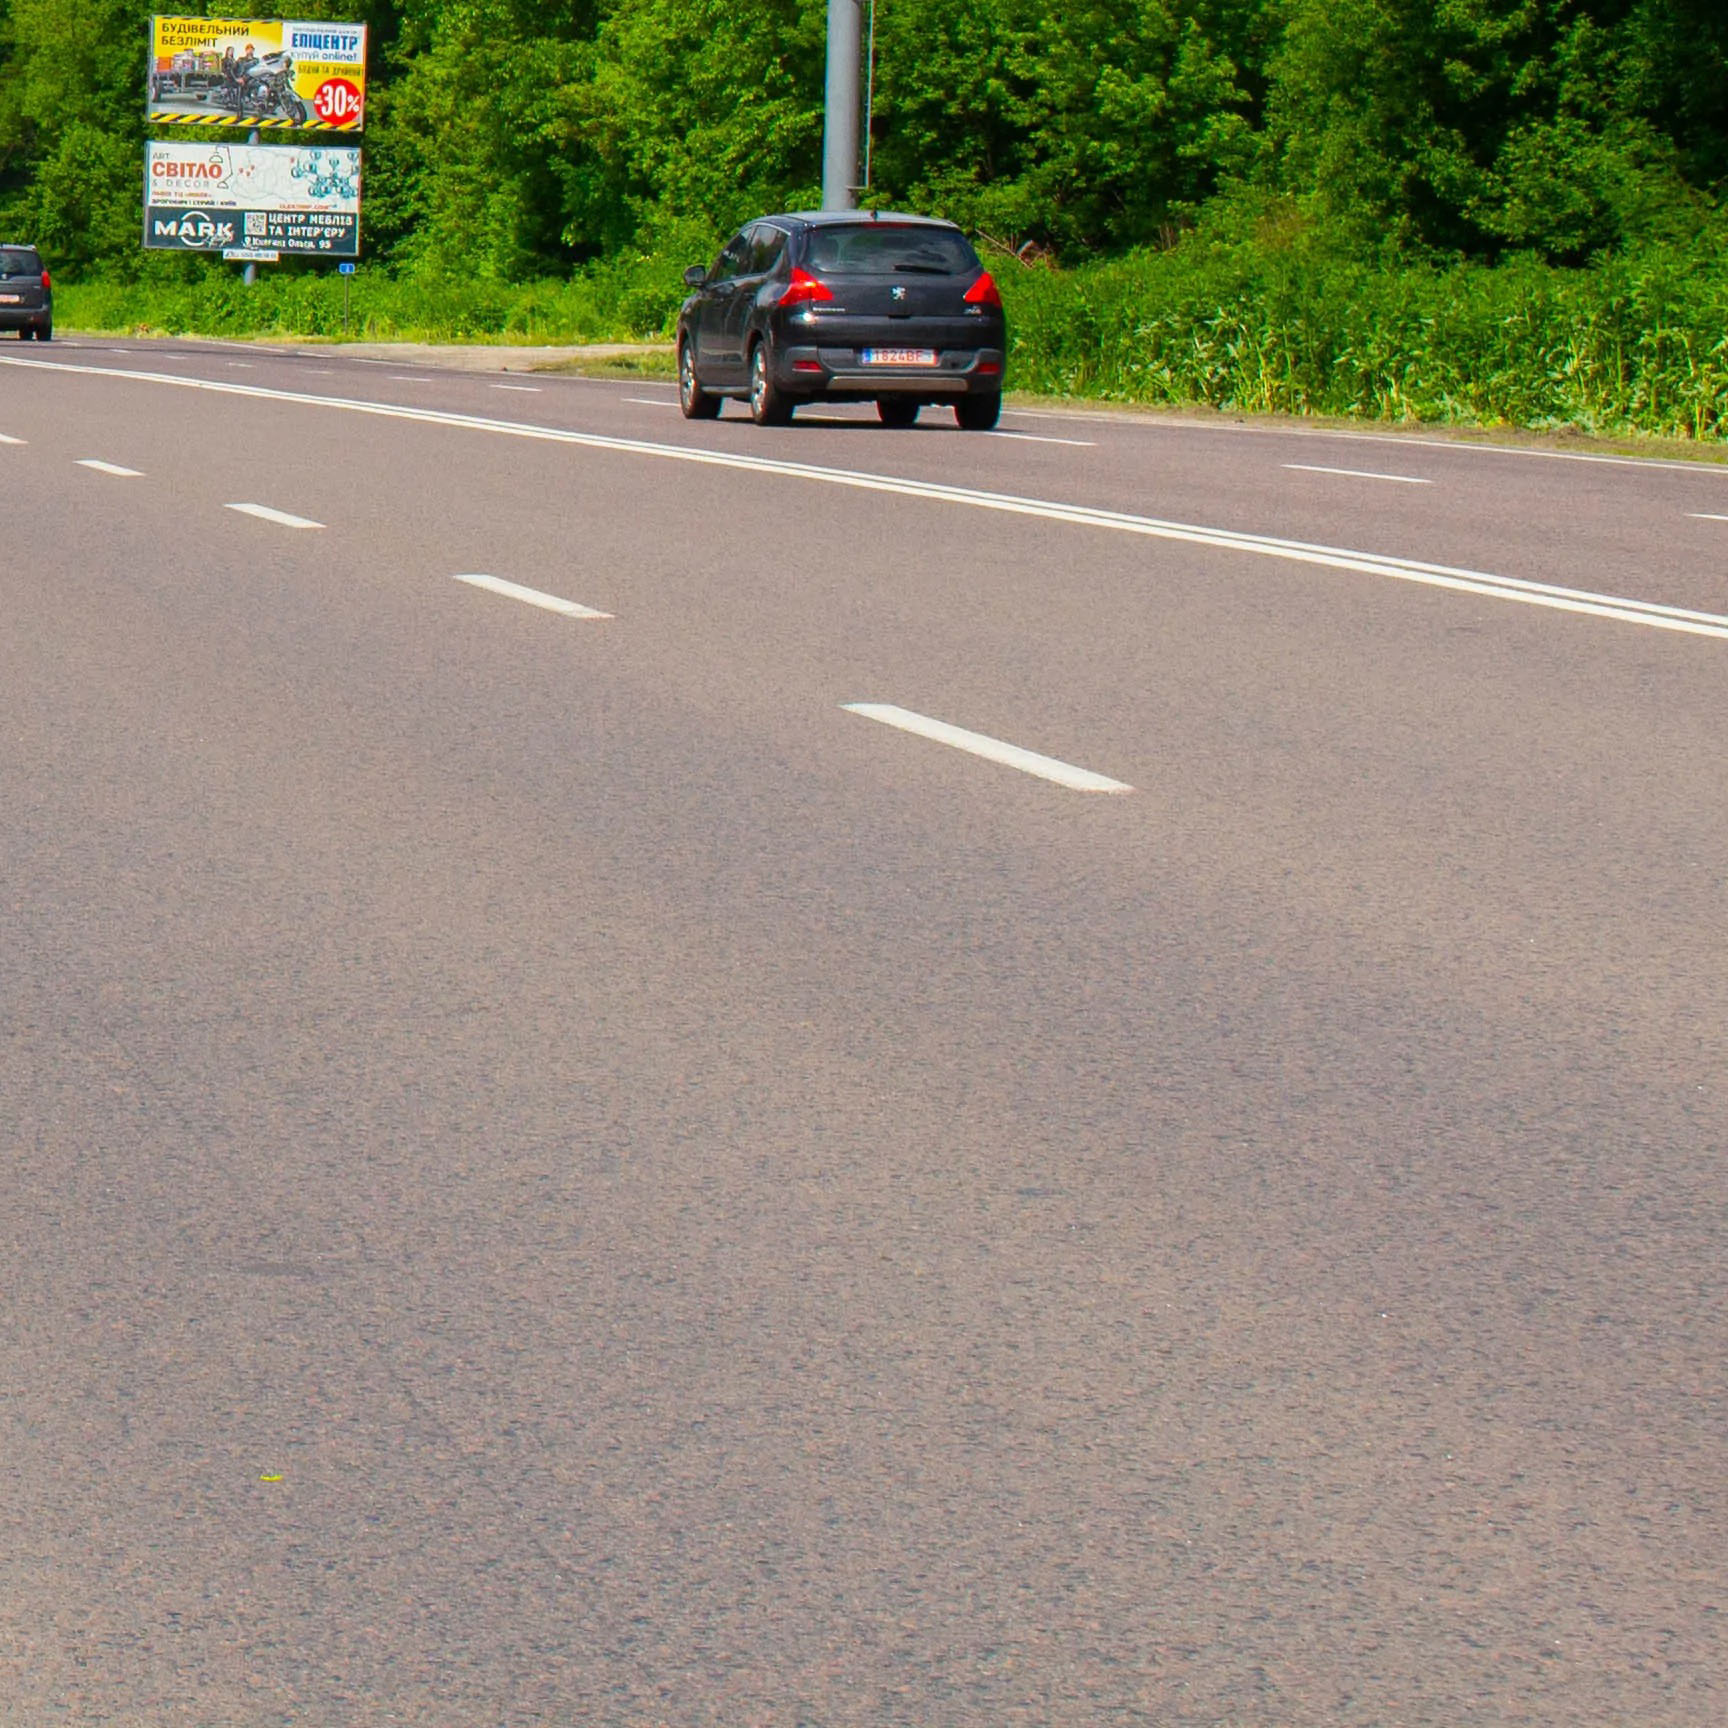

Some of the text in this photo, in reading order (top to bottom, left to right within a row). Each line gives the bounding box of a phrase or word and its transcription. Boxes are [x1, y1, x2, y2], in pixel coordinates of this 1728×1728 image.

[161, 22, 250, 36] БУДІВЕЛЬНИЙ
[161, 35, 218, 48] БЕЗЛІМІТ
[291, 33, 358, 50] ЕПІЦЕНТР
[314, 84, 360, 116] -30%
[152, 161, 222, 179] СВІТЛО
[268, 213, 353, 226] ЦЕНТР МЕБЛІВ
[154, 220, 233, 237] MARK
[268, 225, 284, 236] ТА
